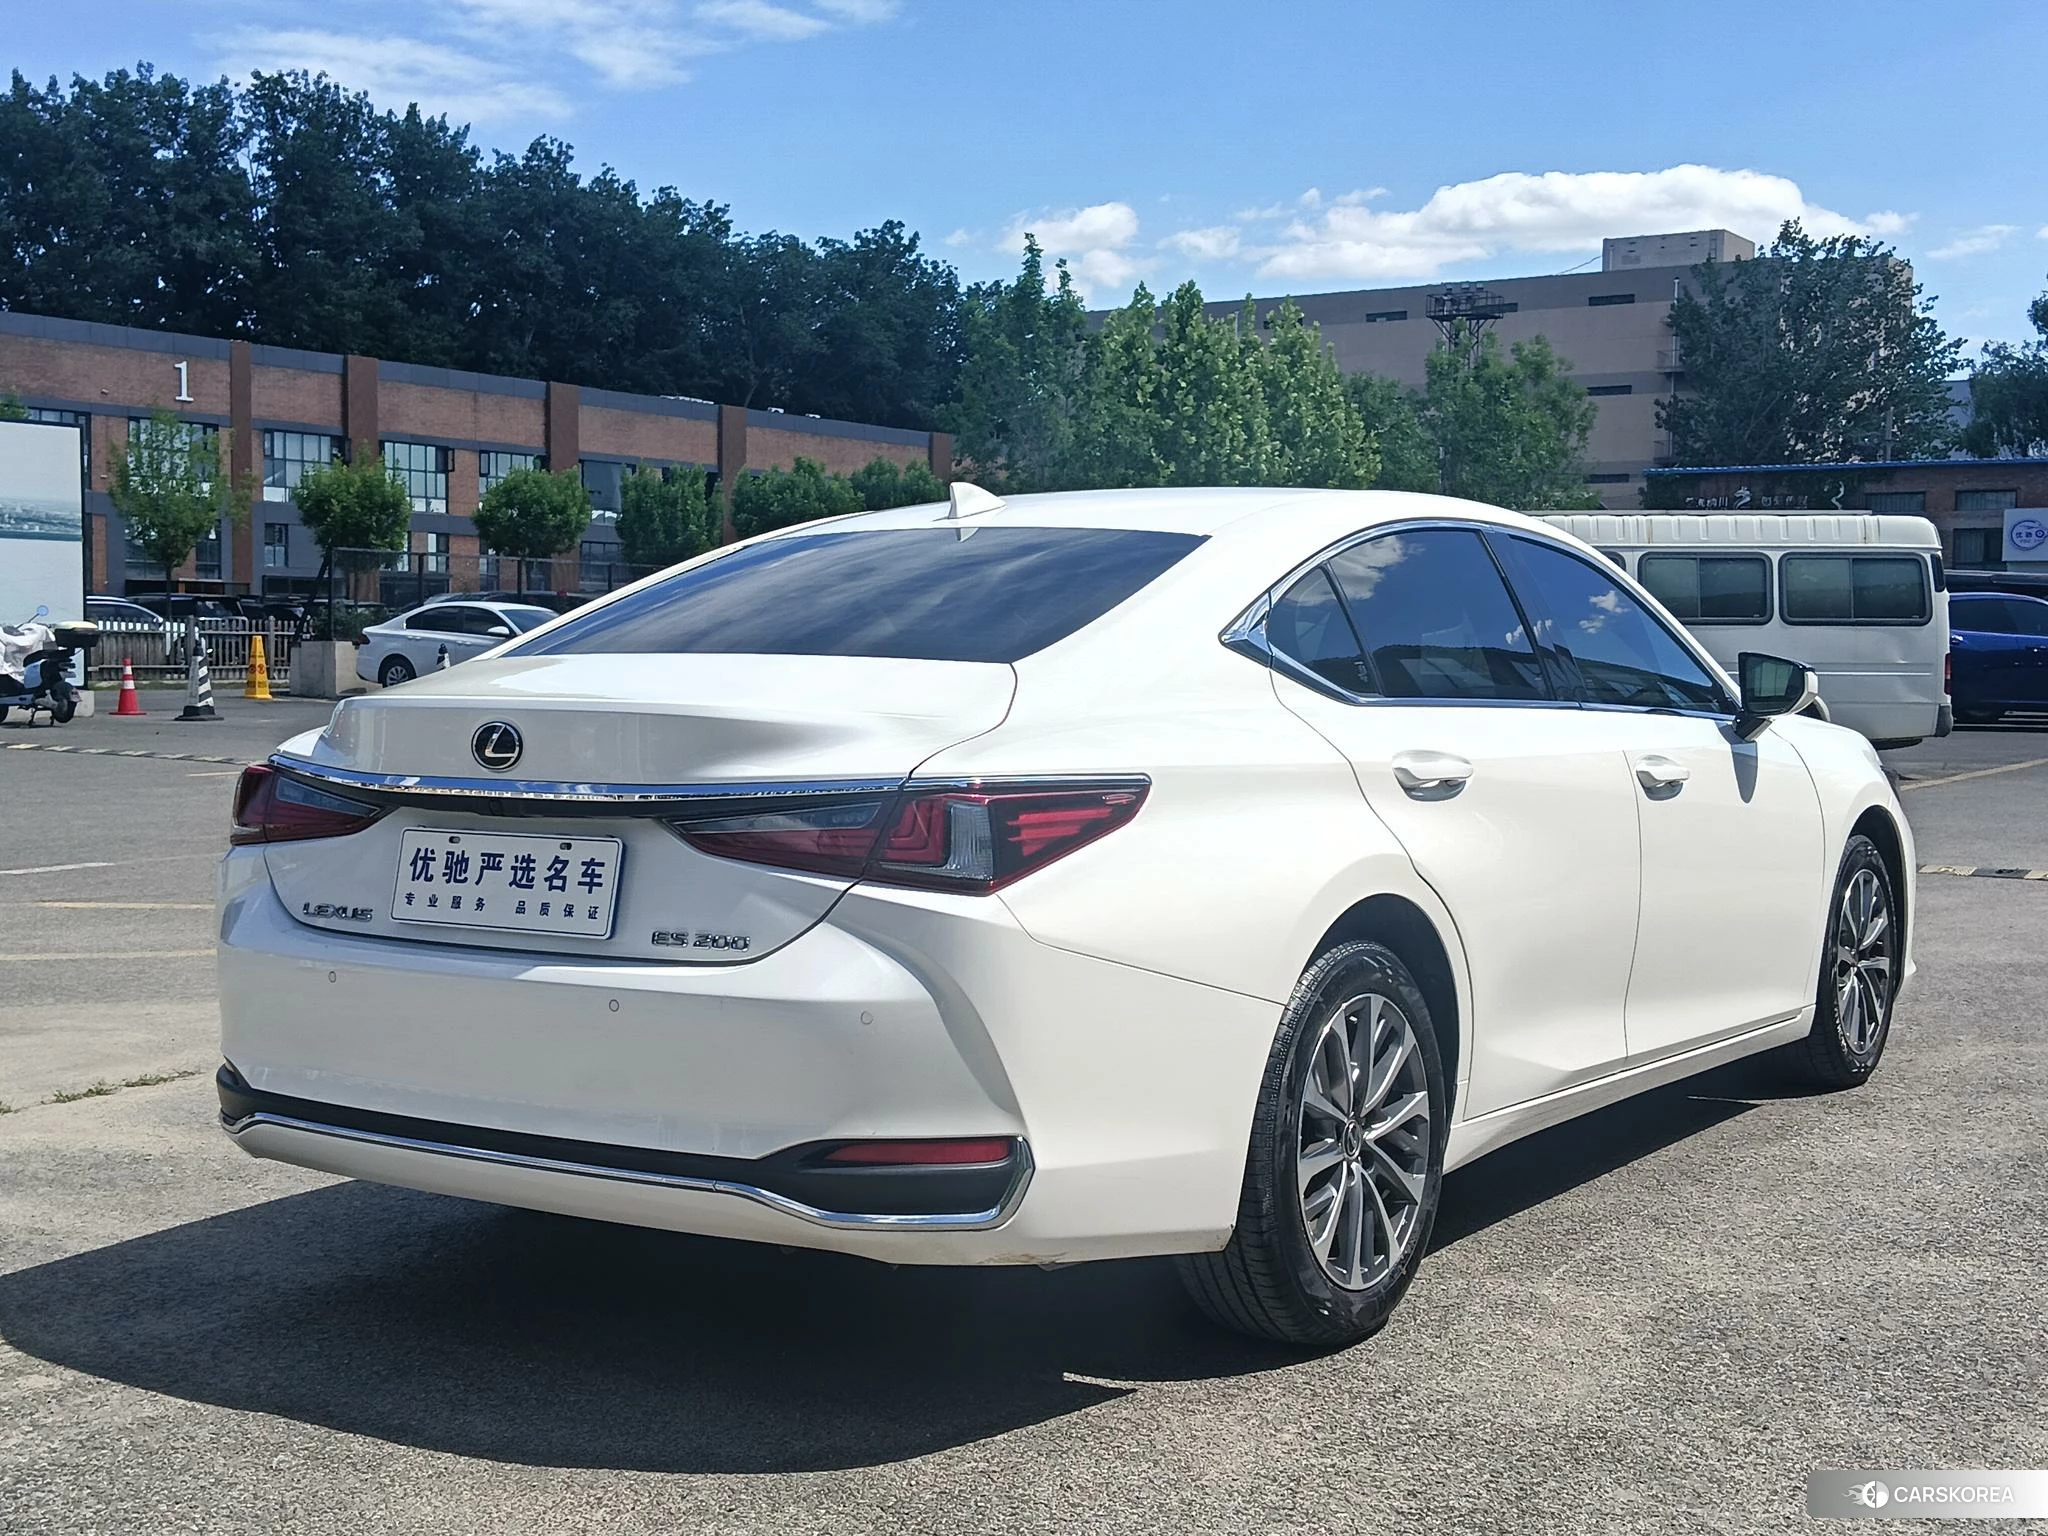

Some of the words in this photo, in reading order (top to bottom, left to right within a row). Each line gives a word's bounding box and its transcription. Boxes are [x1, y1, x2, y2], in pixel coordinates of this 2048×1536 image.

[174, 360, 194, 401] 1
[409, 847, 605, 894] 优驰严选名车
[302, 902, 374, 923] LEXUS
[404, 892, 486, 912] 专业服务
[515, 900, 600, 920] 品质保证
[651, 931, 688, 948] ES
[692, 933, 750, 952] 200
